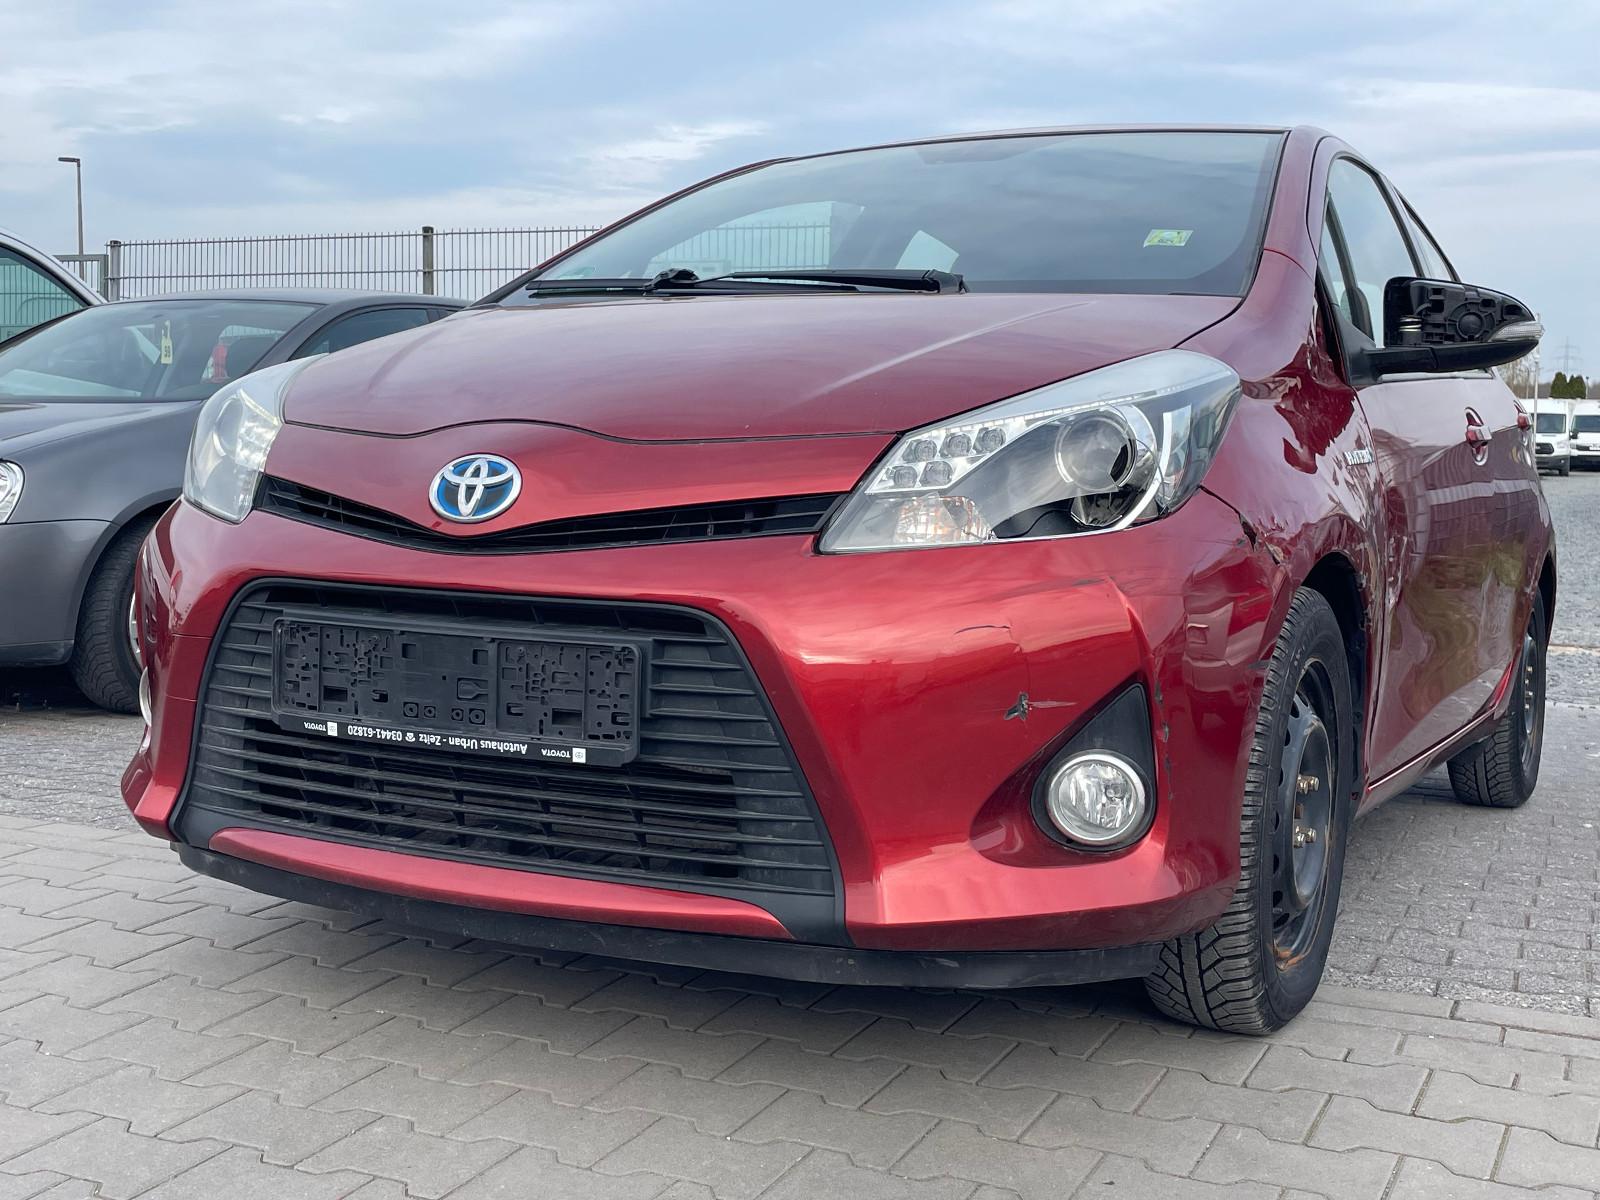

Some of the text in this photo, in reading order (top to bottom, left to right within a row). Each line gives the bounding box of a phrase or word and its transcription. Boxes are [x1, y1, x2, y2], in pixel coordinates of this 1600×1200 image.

[304, 721, 326, 731] TOYOTA
[348, 725, 402, 740] 03441-61820
[419, 733, 442, 745] Zeitz
[448, 736, 477, 749] Urban
[481, 740, 528, 754] Autohaus
[542, 748, 571, 758] TOYOTA
